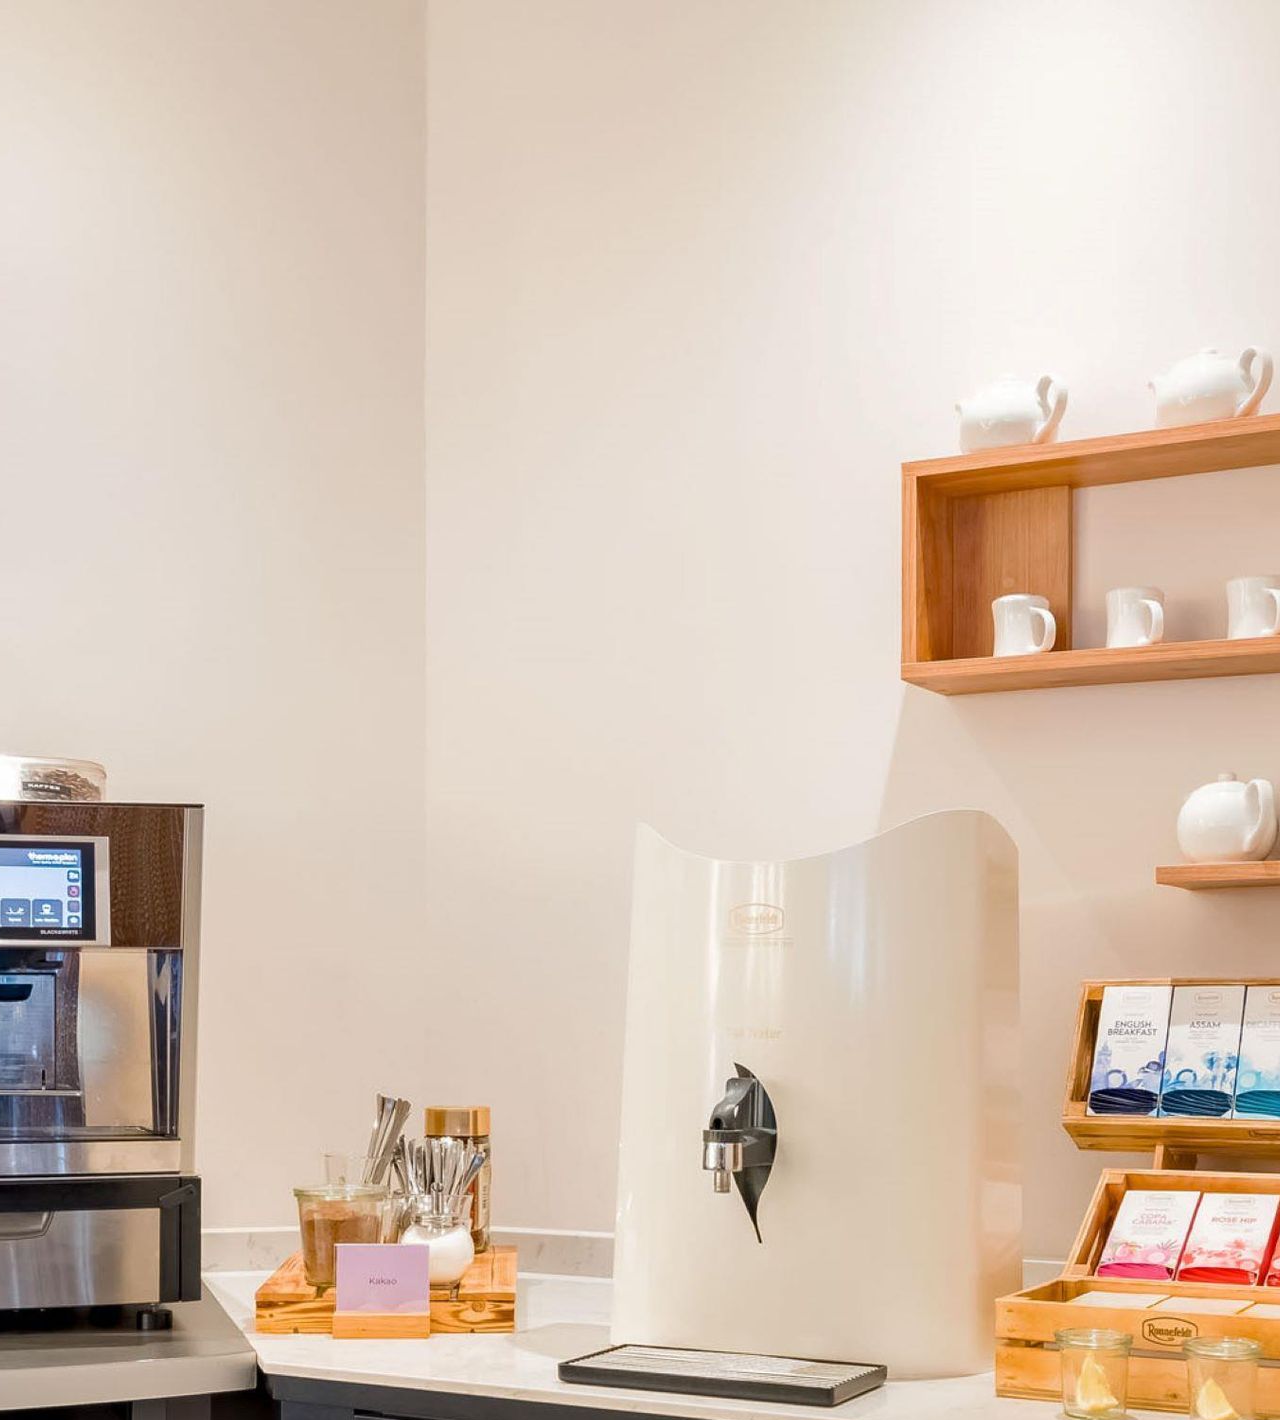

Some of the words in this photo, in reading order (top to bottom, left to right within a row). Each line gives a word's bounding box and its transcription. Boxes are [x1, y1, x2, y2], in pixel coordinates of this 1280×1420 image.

[27, 782, 61, 791] KAFFEE
[1114, 1020, 1152, 1028] ENGLISH
[1189, 1020, 1221, 1029] ASSAM
[1107, 1028, 1158, 1036] BREAKFAST
[1211, 1216, 1238, 1225] ROSE
[1239, 1217, 1258, 1225] HIP
[369, 1277, 397, 1285] Kakao
